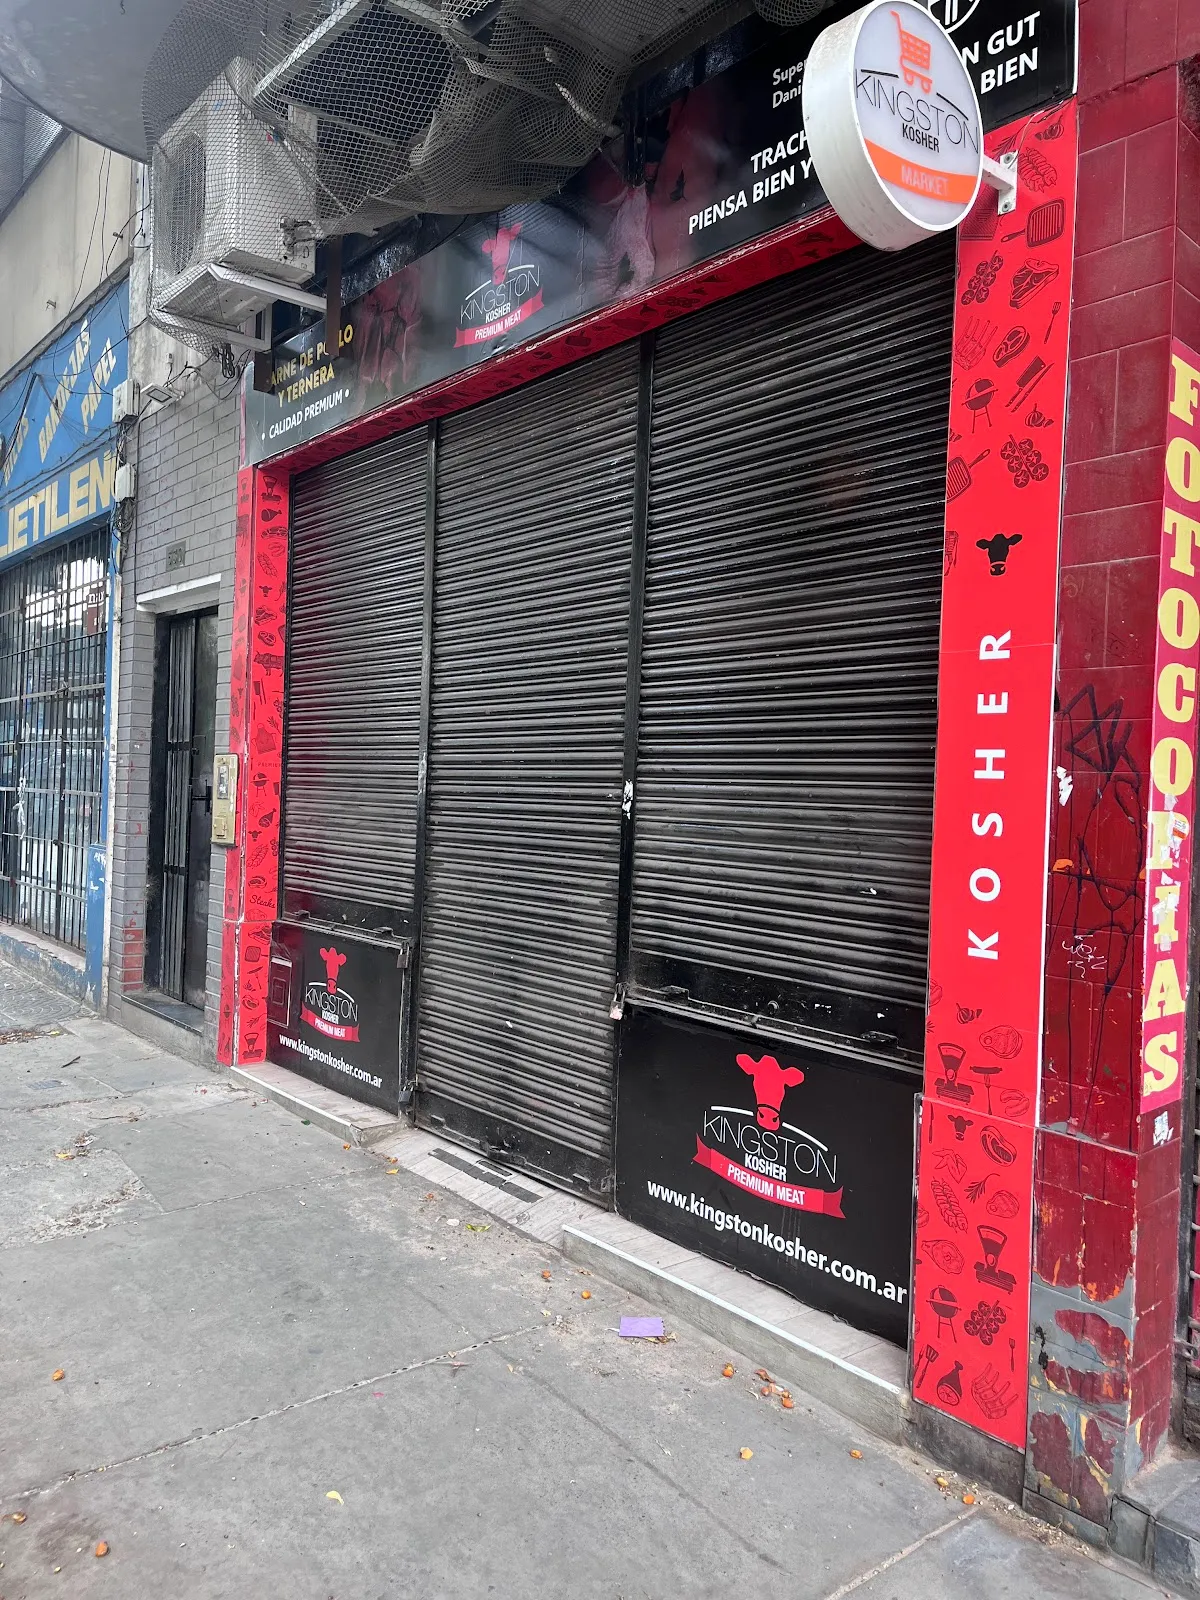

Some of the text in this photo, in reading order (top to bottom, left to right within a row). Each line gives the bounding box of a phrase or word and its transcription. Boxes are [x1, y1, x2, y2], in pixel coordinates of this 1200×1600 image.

[987, 10, 1041, 55] GUT
[856, 68, 979, 154] KINGSTON
[688, 47, 1039, 236] PIENSA BIEN Y BIEN
[902, 122, 940, 153] KOSHER
[901, 164, 949, 196] MARKET
[460, 265, 540, 324] KINGSTON
[485, 302, 511, 323] KOSHER
[474, 309, 522, 340] PREMIUM MEAT
[271, 324, 354, 386] ARNE DE PLO
[80, 337, 117, 435] PAPEL
[278, 362, 335, 408] Y TERNERA
[269, 388, 343, 439] CALIDAD PREMIUM
[0, 449, 117, 558] IETILEN
[967, 629, 1012, 961] KOSHER
[250, 894, 276, 909] Steaks
[305, 986, 359, 1022] KINGSTON
[321, 1009, 339, 1025] KOSHER
[314, 1018, 346, 1038] PREMIUM MEAT
[279, 1034, 383, 1089] www.kingstonkosher.com.ar
[703, 1111, 837, 1184] KINGSTON
[744, 1153, 787, 1182] KOSHER
[727, 1163, 806, 1206] PREMIUM MEAT
[647, 1180, 908, 1304] www.kingstonkosher.com.ar
